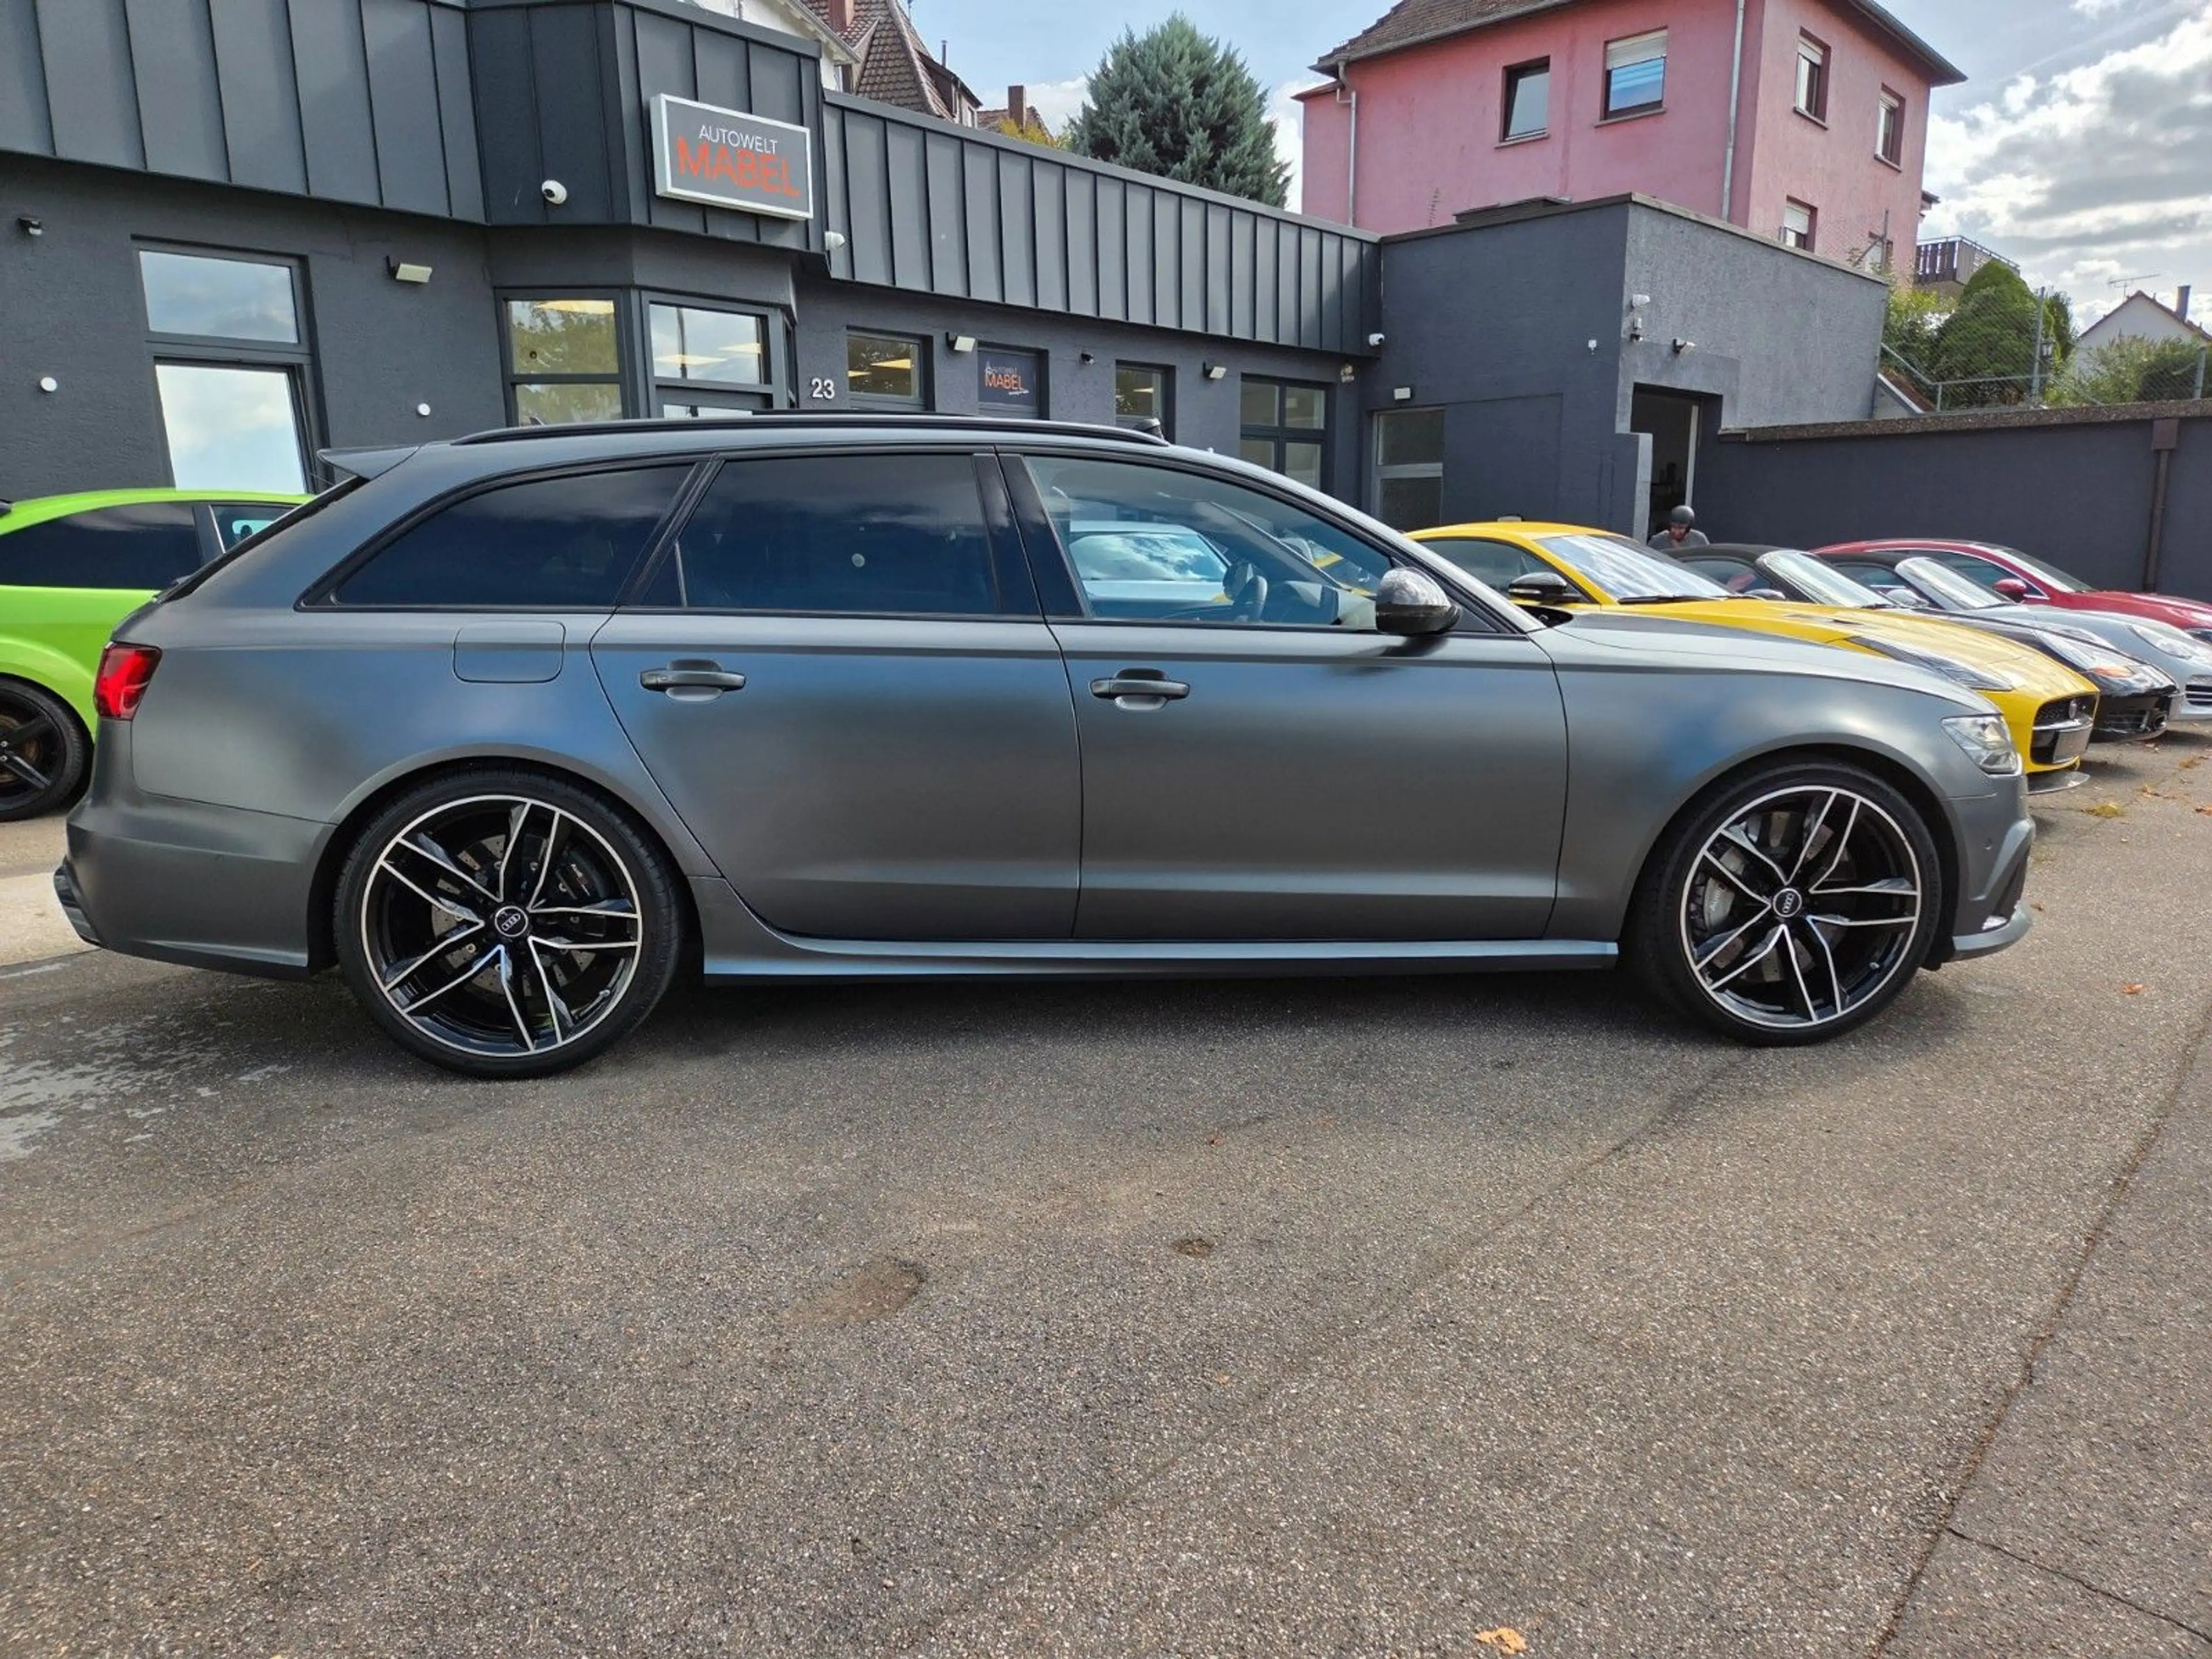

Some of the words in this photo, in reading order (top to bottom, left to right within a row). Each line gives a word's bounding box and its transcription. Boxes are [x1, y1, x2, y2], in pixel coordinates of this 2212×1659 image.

[699, 125, 778, 154] AUTOWELT
[677, 135, 799, 197] MABEL
[811, 377, 835, 399] 23
[985, 373, 1024, 390] MABEL
